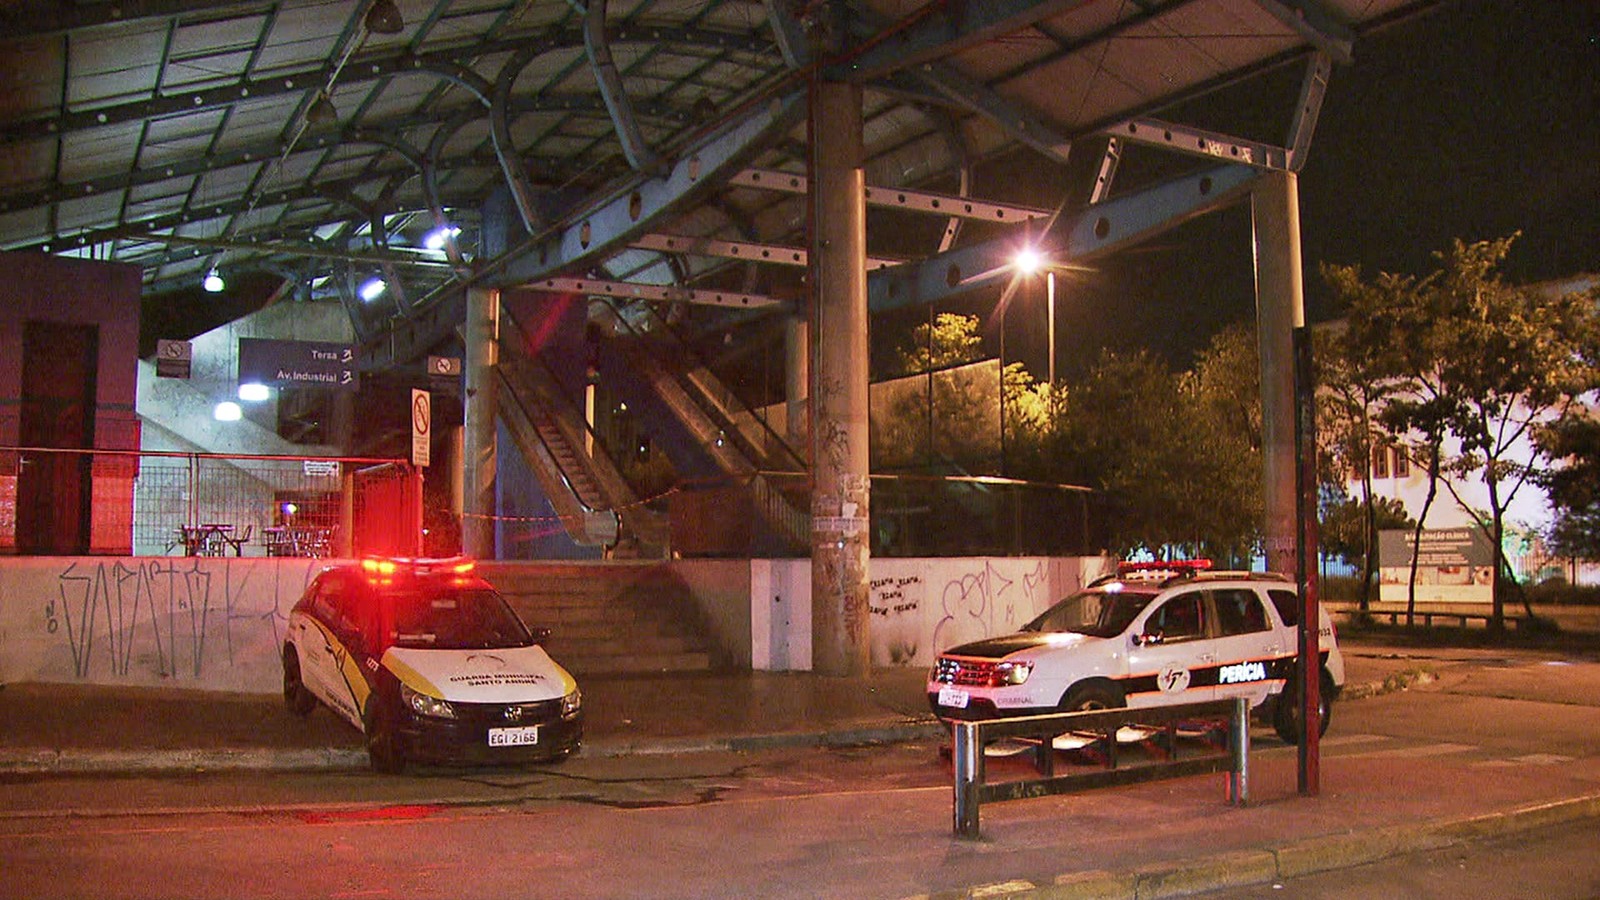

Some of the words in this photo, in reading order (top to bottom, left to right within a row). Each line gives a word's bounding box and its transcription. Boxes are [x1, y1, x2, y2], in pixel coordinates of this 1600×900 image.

[311, 350, 338, 360] Tersa
[293, 371, 337, 383] Industrial
[1219, 660, 1266, 685] PERÍCIA
